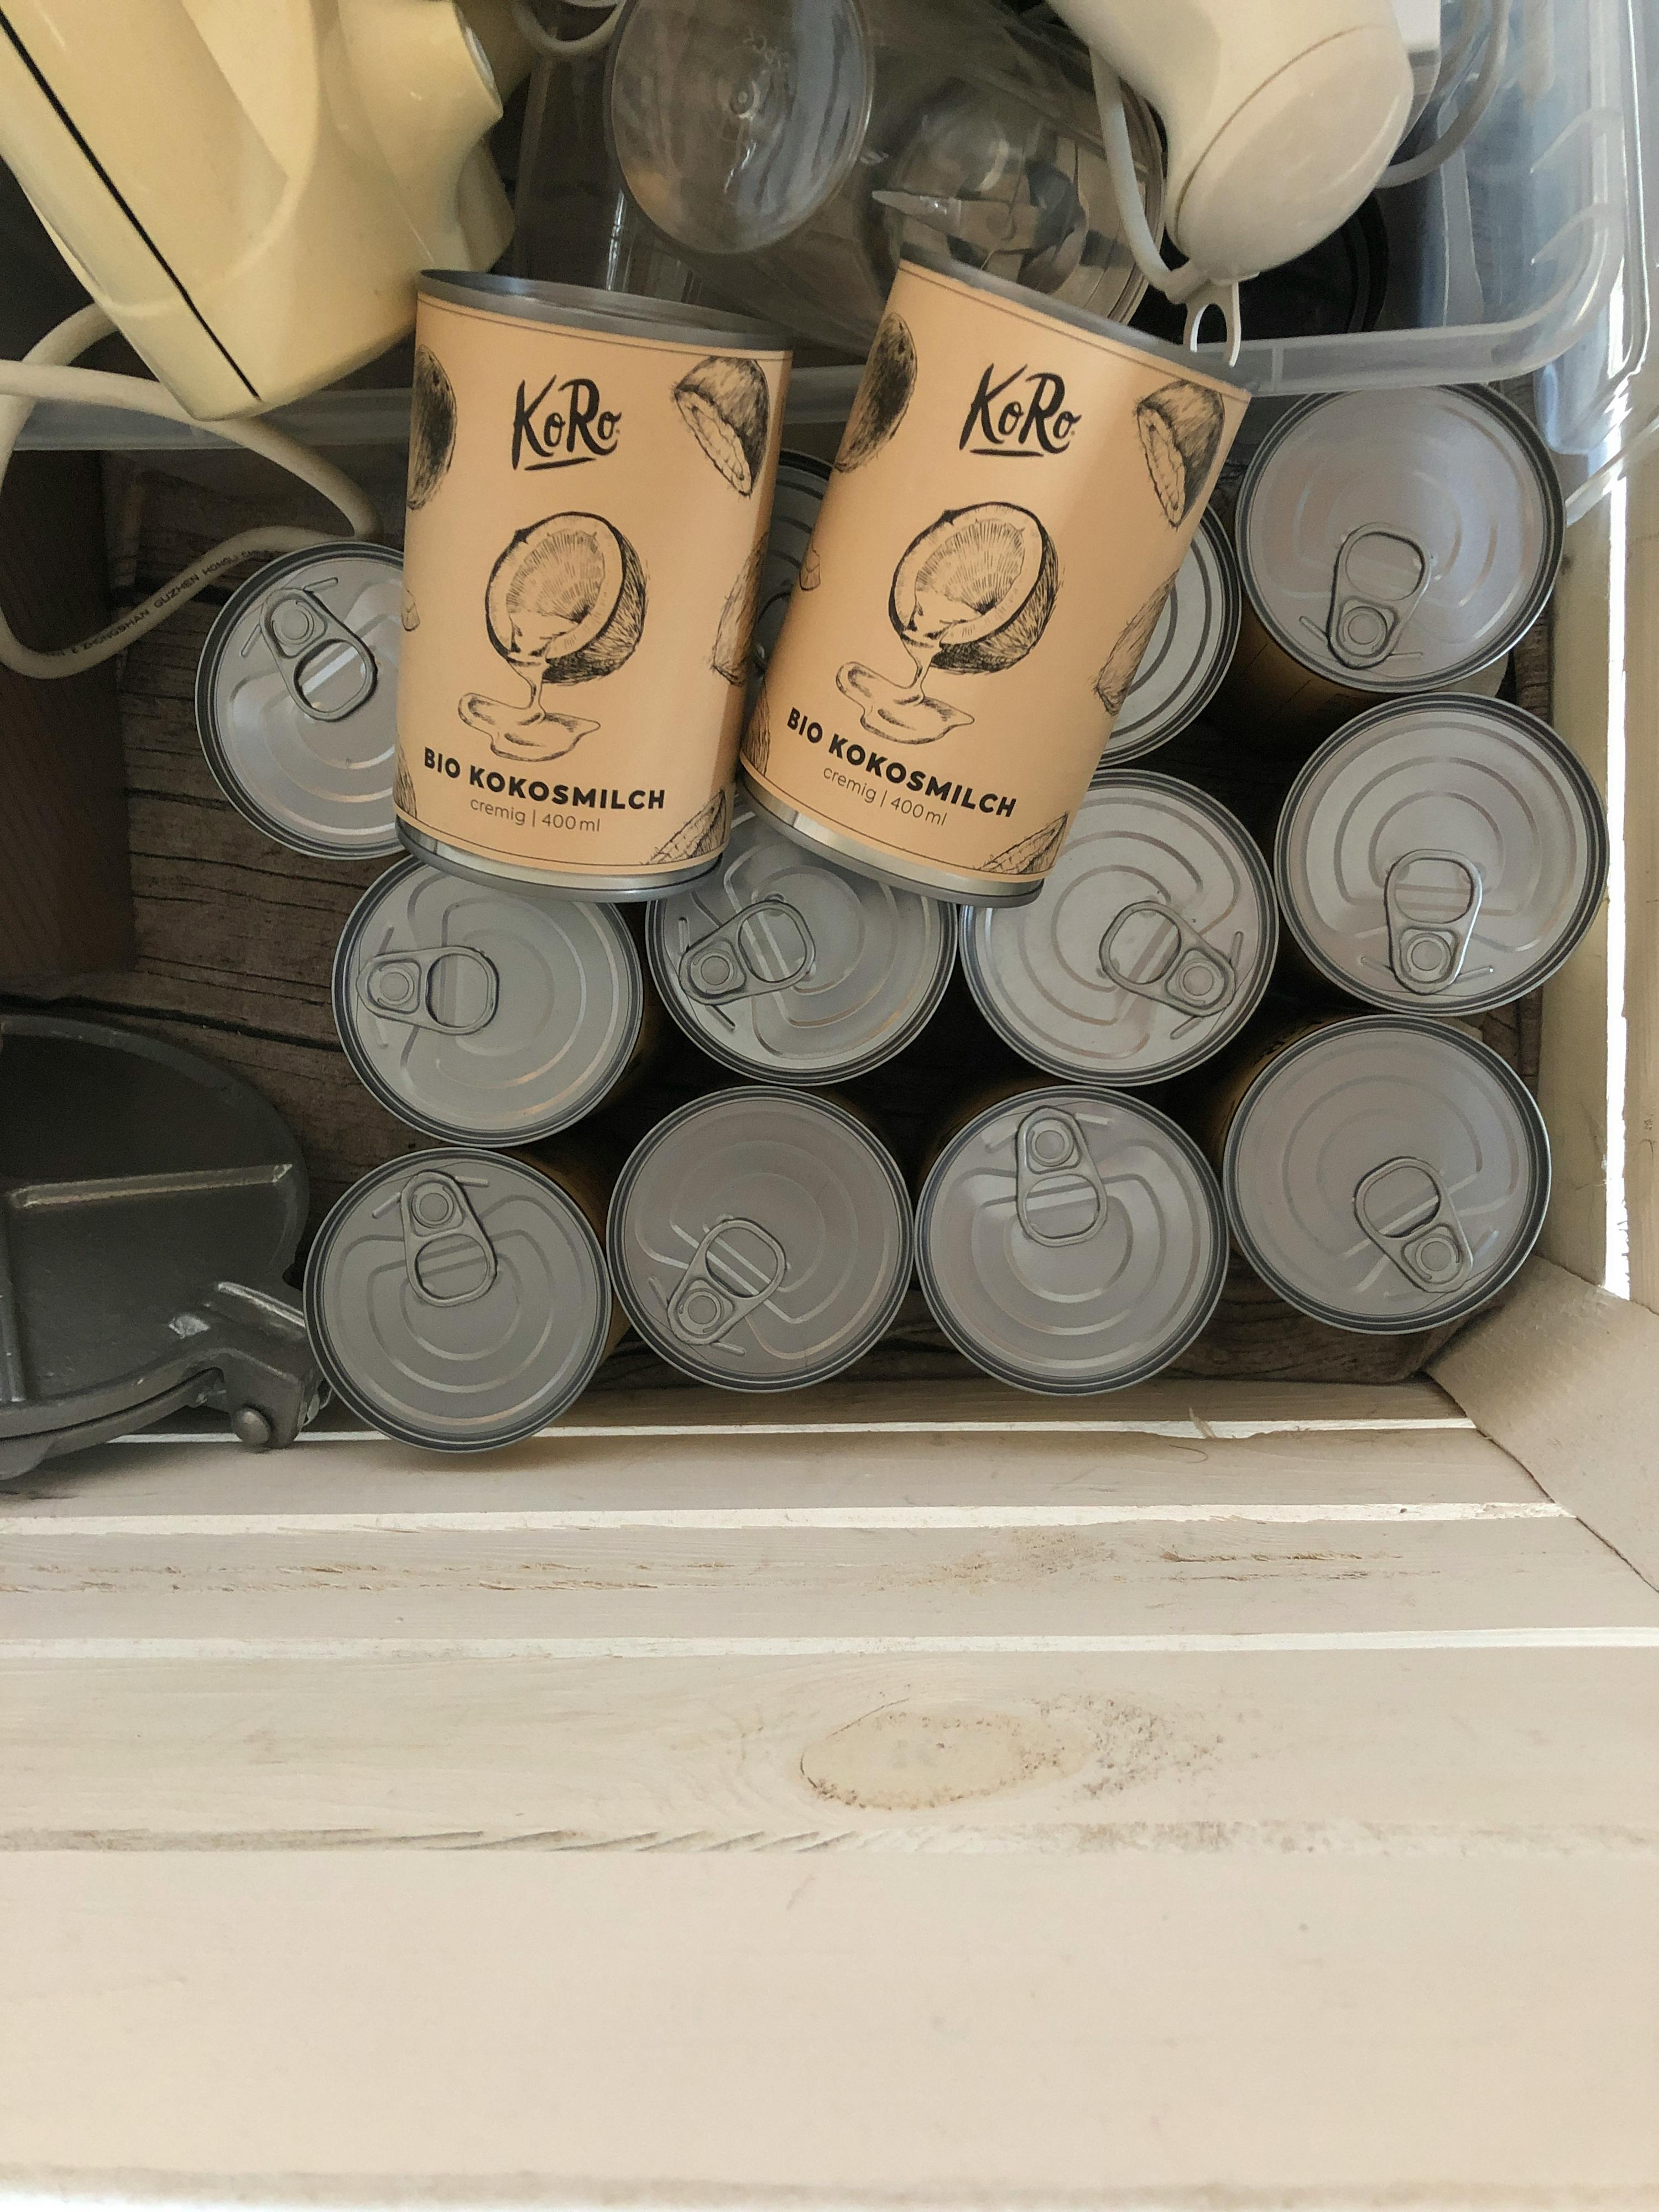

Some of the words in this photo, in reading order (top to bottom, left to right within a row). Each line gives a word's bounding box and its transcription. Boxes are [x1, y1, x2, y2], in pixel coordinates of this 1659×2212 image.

[512, 374, 622, 470] KoRo
[959, 363, 1082, 456] KoRo
[154, 573, 200, 608] GUZHEN
[424, 747, 461, 779] BIO
[469, 765, 665, 810] KOKOSMILCH
[787, 707, 823, 744] BIO
[828, 733, 1016, 818] KOKOSMILCH
[470, 797, 526, 826] cremig
[541, 813, 601, 832] 400ml
[823, 766, 877, 804] cremig
[890, 797, 947, 826] 400ml
